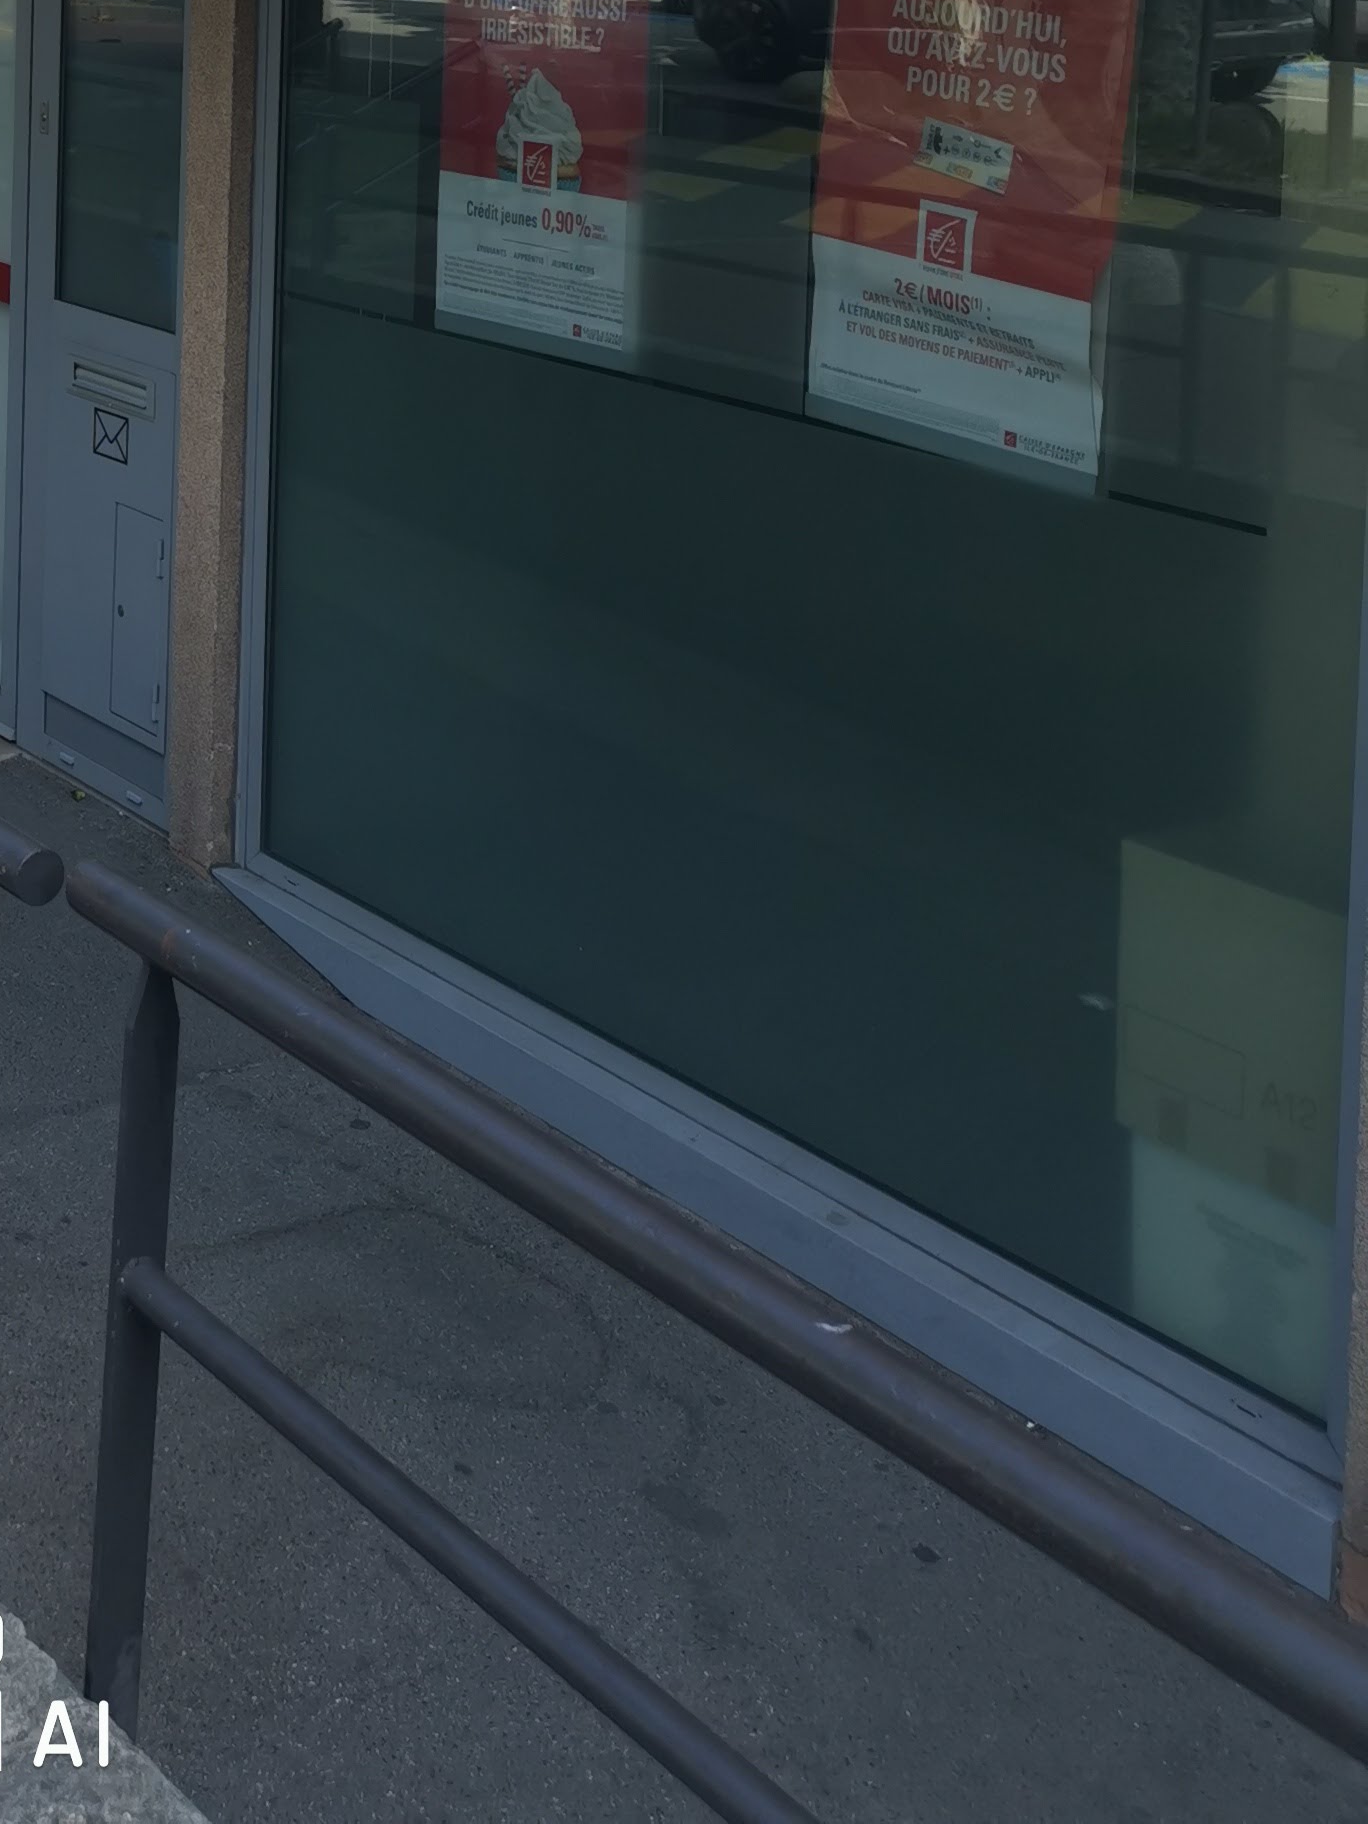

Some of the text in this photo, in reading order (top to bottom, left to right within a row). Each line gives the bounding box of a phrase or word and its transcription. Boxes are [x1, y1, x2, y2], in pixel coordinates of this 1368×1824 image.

[887, 26, 1068, 84] QU'AVEZ-VOUS
[905, 66, 971, 104] POUR
[1024, 87, 1038, 116] ?
[466, 199, 499, 223] Crédit
[501, 205, 538, 229] jeunes
[542, 207, 592, 238] 0,90%
[862, 289, 891, 307] CARTE
[848, 301, 902, 327] L'ÉTRANGER
[903, 317, 930, 334] SANS
[846, 320, 858, 334] ET
[859, 323, 877, 339] VOL
[878, 328, 897, 344] DES
[898, 333, 941, 354] MOYENS
[942, 343, 956, 358] DE
